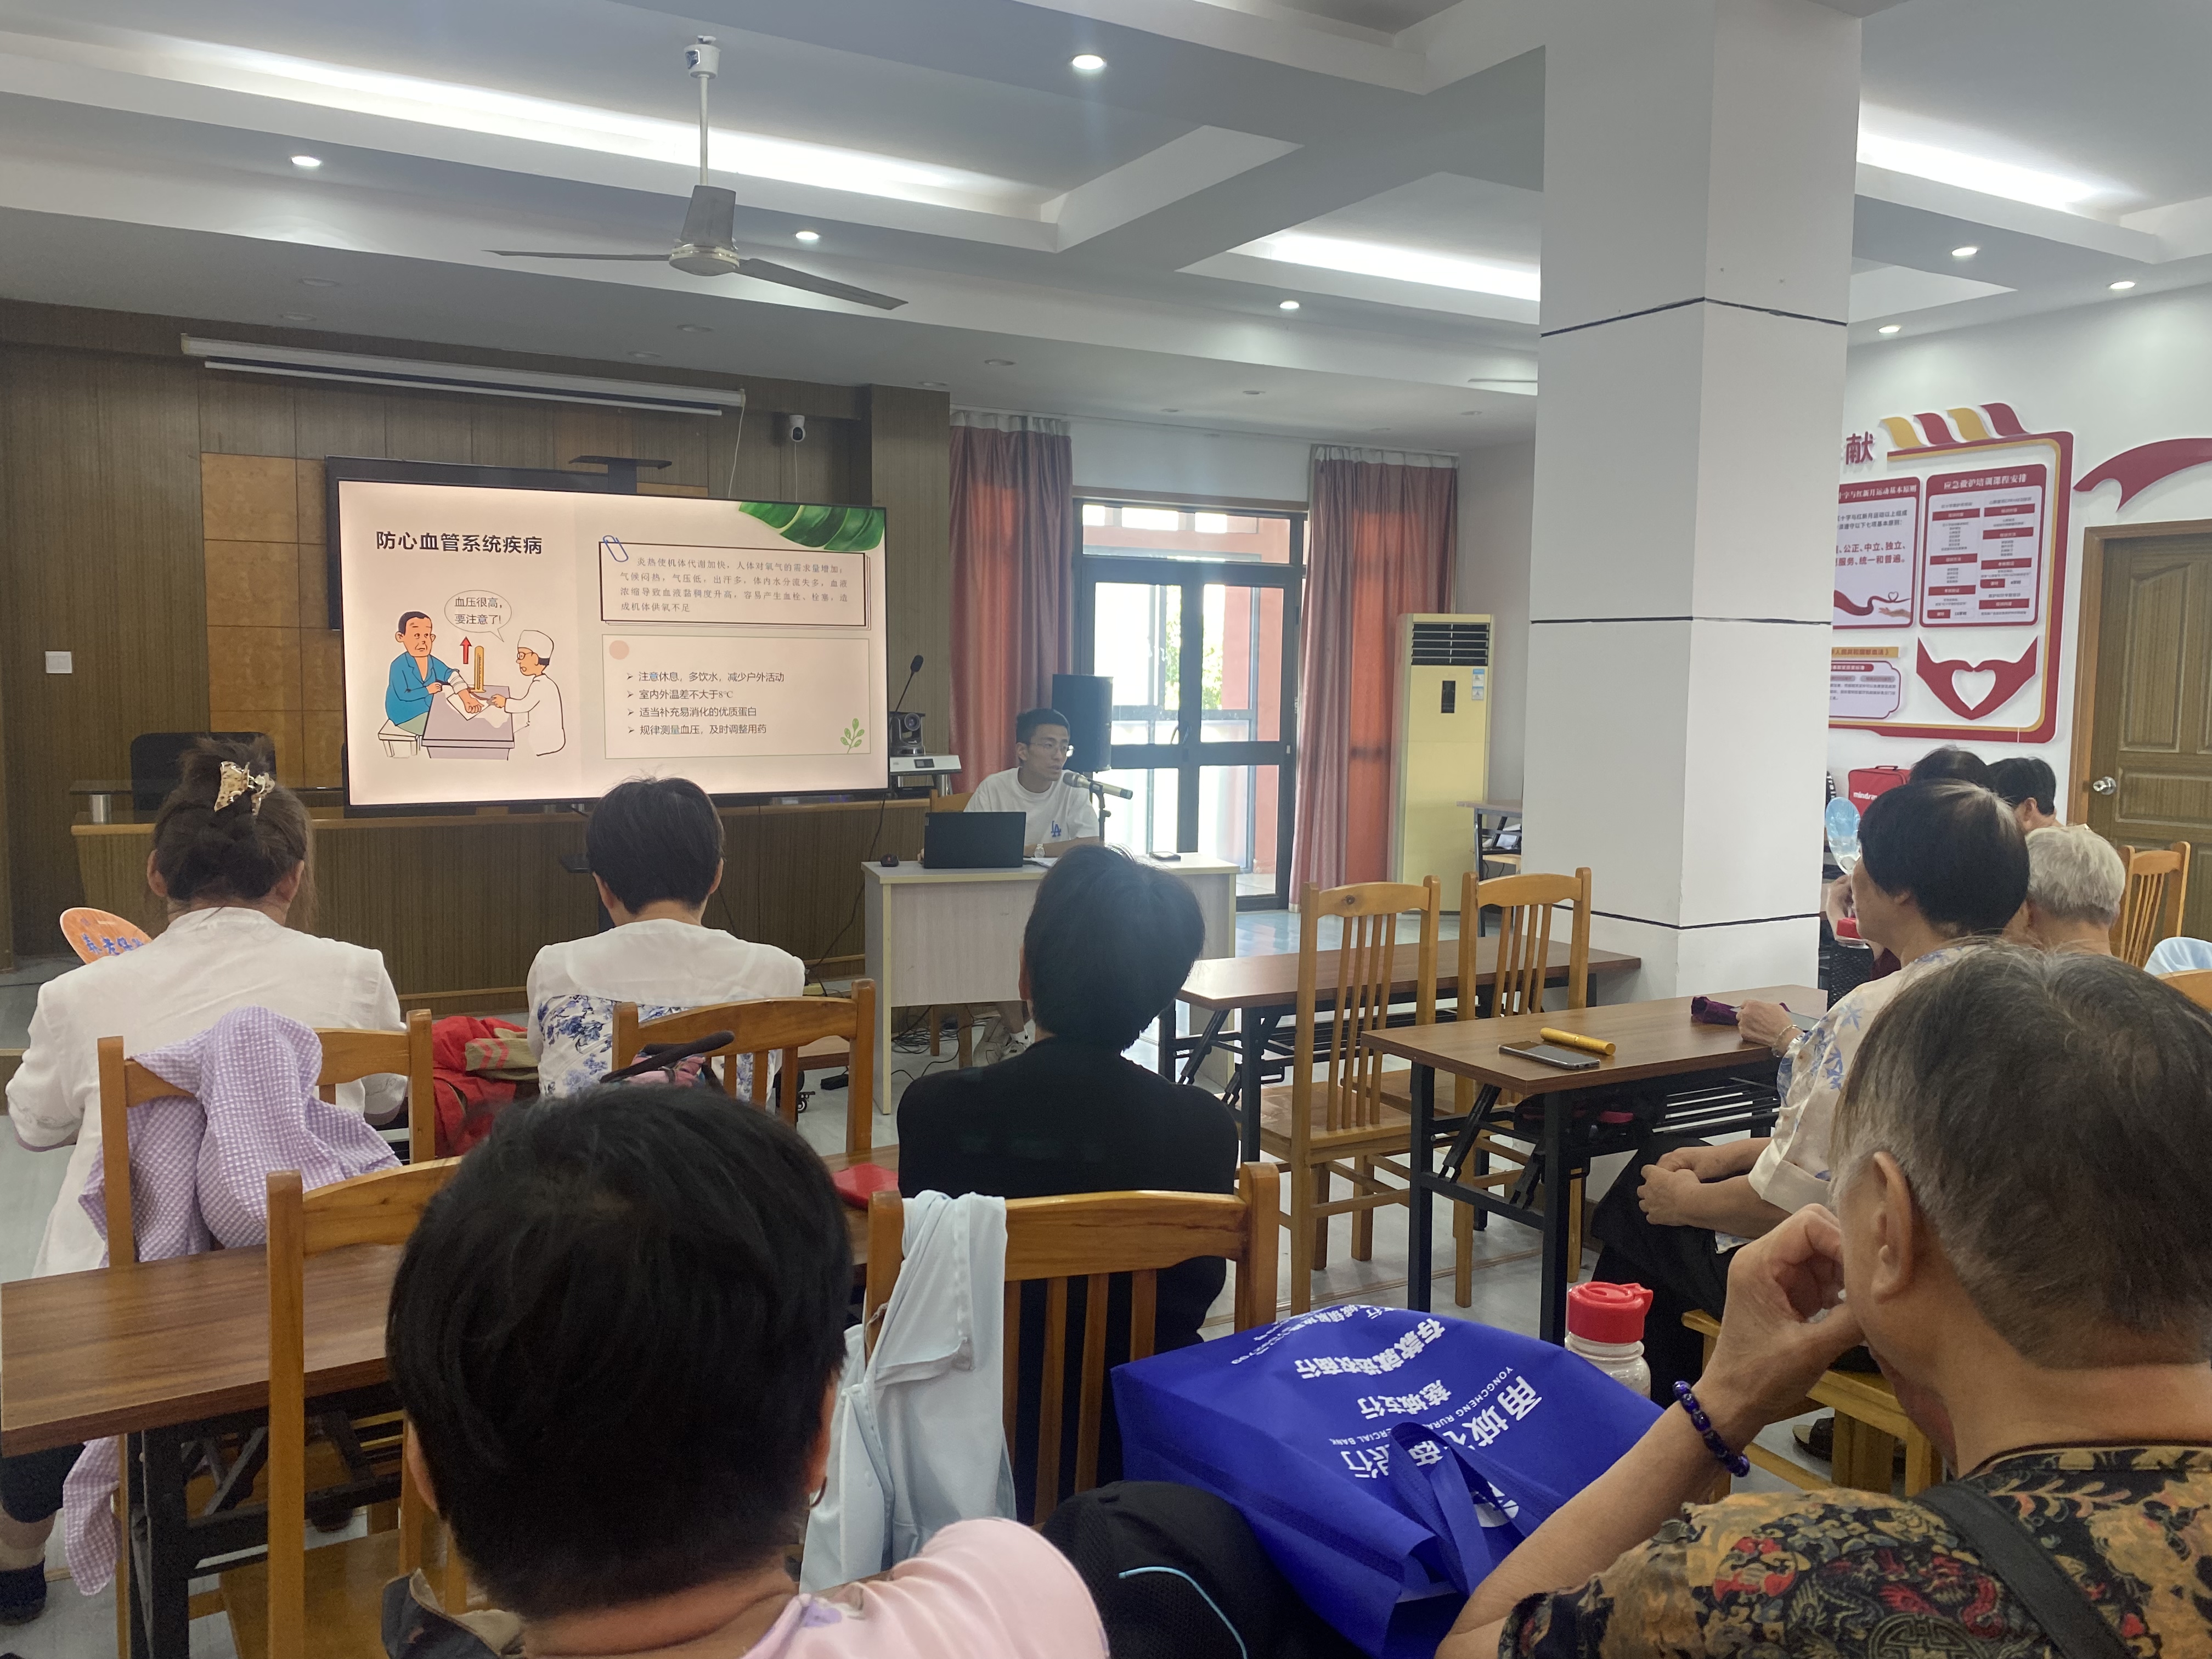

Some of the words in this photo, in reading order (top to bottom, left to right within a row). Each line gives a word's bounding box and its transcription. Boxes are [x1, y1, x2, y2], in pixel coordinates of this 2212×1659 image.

[1846, 431, 1874, 465] 献
[1943, 473, 2027, 490] 应急救护培训课程安排
[376, 531, 543, 554] 防心血管系统疾病
[1836, 540, 1905, 554] 、公正、中立、独立、
[1836, 554, 1905, 567] 服务、统一和普遍。
[620, 602, 691, 612] 成机体供氧不足
[639, 672, 785, 682] 注意休息，多饮水，减少户外活动
[639, 707, 757, 718] 适当补充易消化的优质蛋白
[640, 724, 767, 736] 规律测量血压，及时调整用药
[1051, 820, 1062, 837] LA
[1294, 1318, 1446, 1379] 存款就选农商行
[1357, 1379, 1452, 1420] 慈城支行
[1455, 1366, 1514, 1418] YONGCHENG
[1328, 1437, 1357, 1446] BANK
